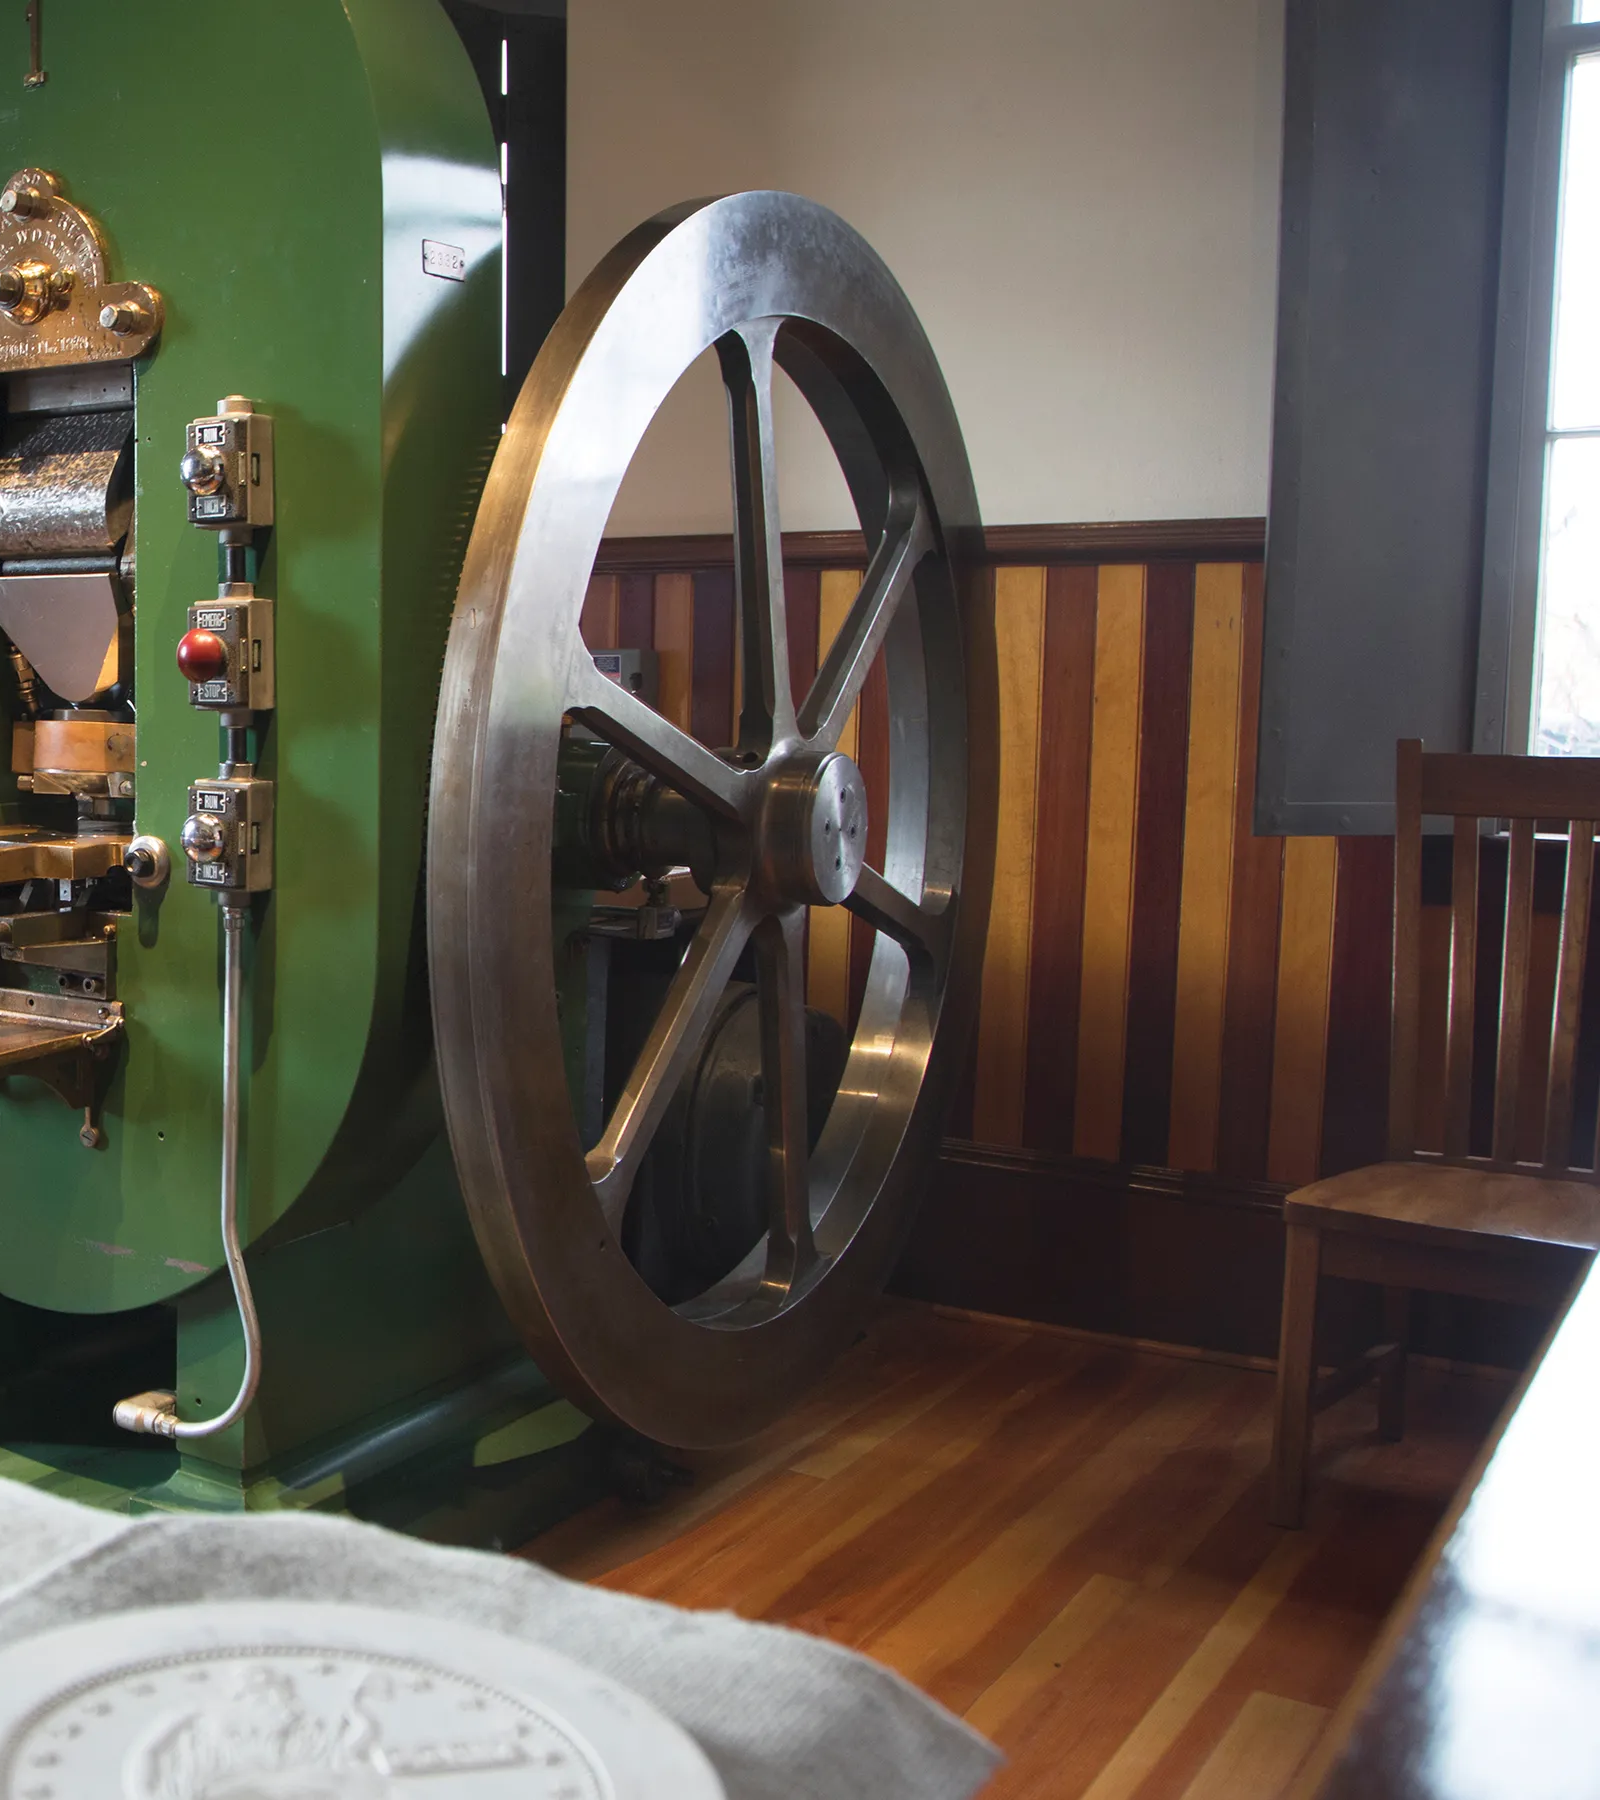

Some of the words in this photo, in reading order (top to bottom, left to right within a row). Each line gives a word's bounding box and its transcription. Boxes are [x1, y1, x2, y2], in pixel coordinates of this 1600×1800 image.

[15, 228, 77, 272] WORKS
[203, 427, 218, 443] RUN
[204, 499, 219, 514] INCH
[201, 613, 221, 627] EMERG
[204, 684, 221, 698] STOP
[204, 794, 218, 809] RUN
[203, 864, 218, 879] INCH
